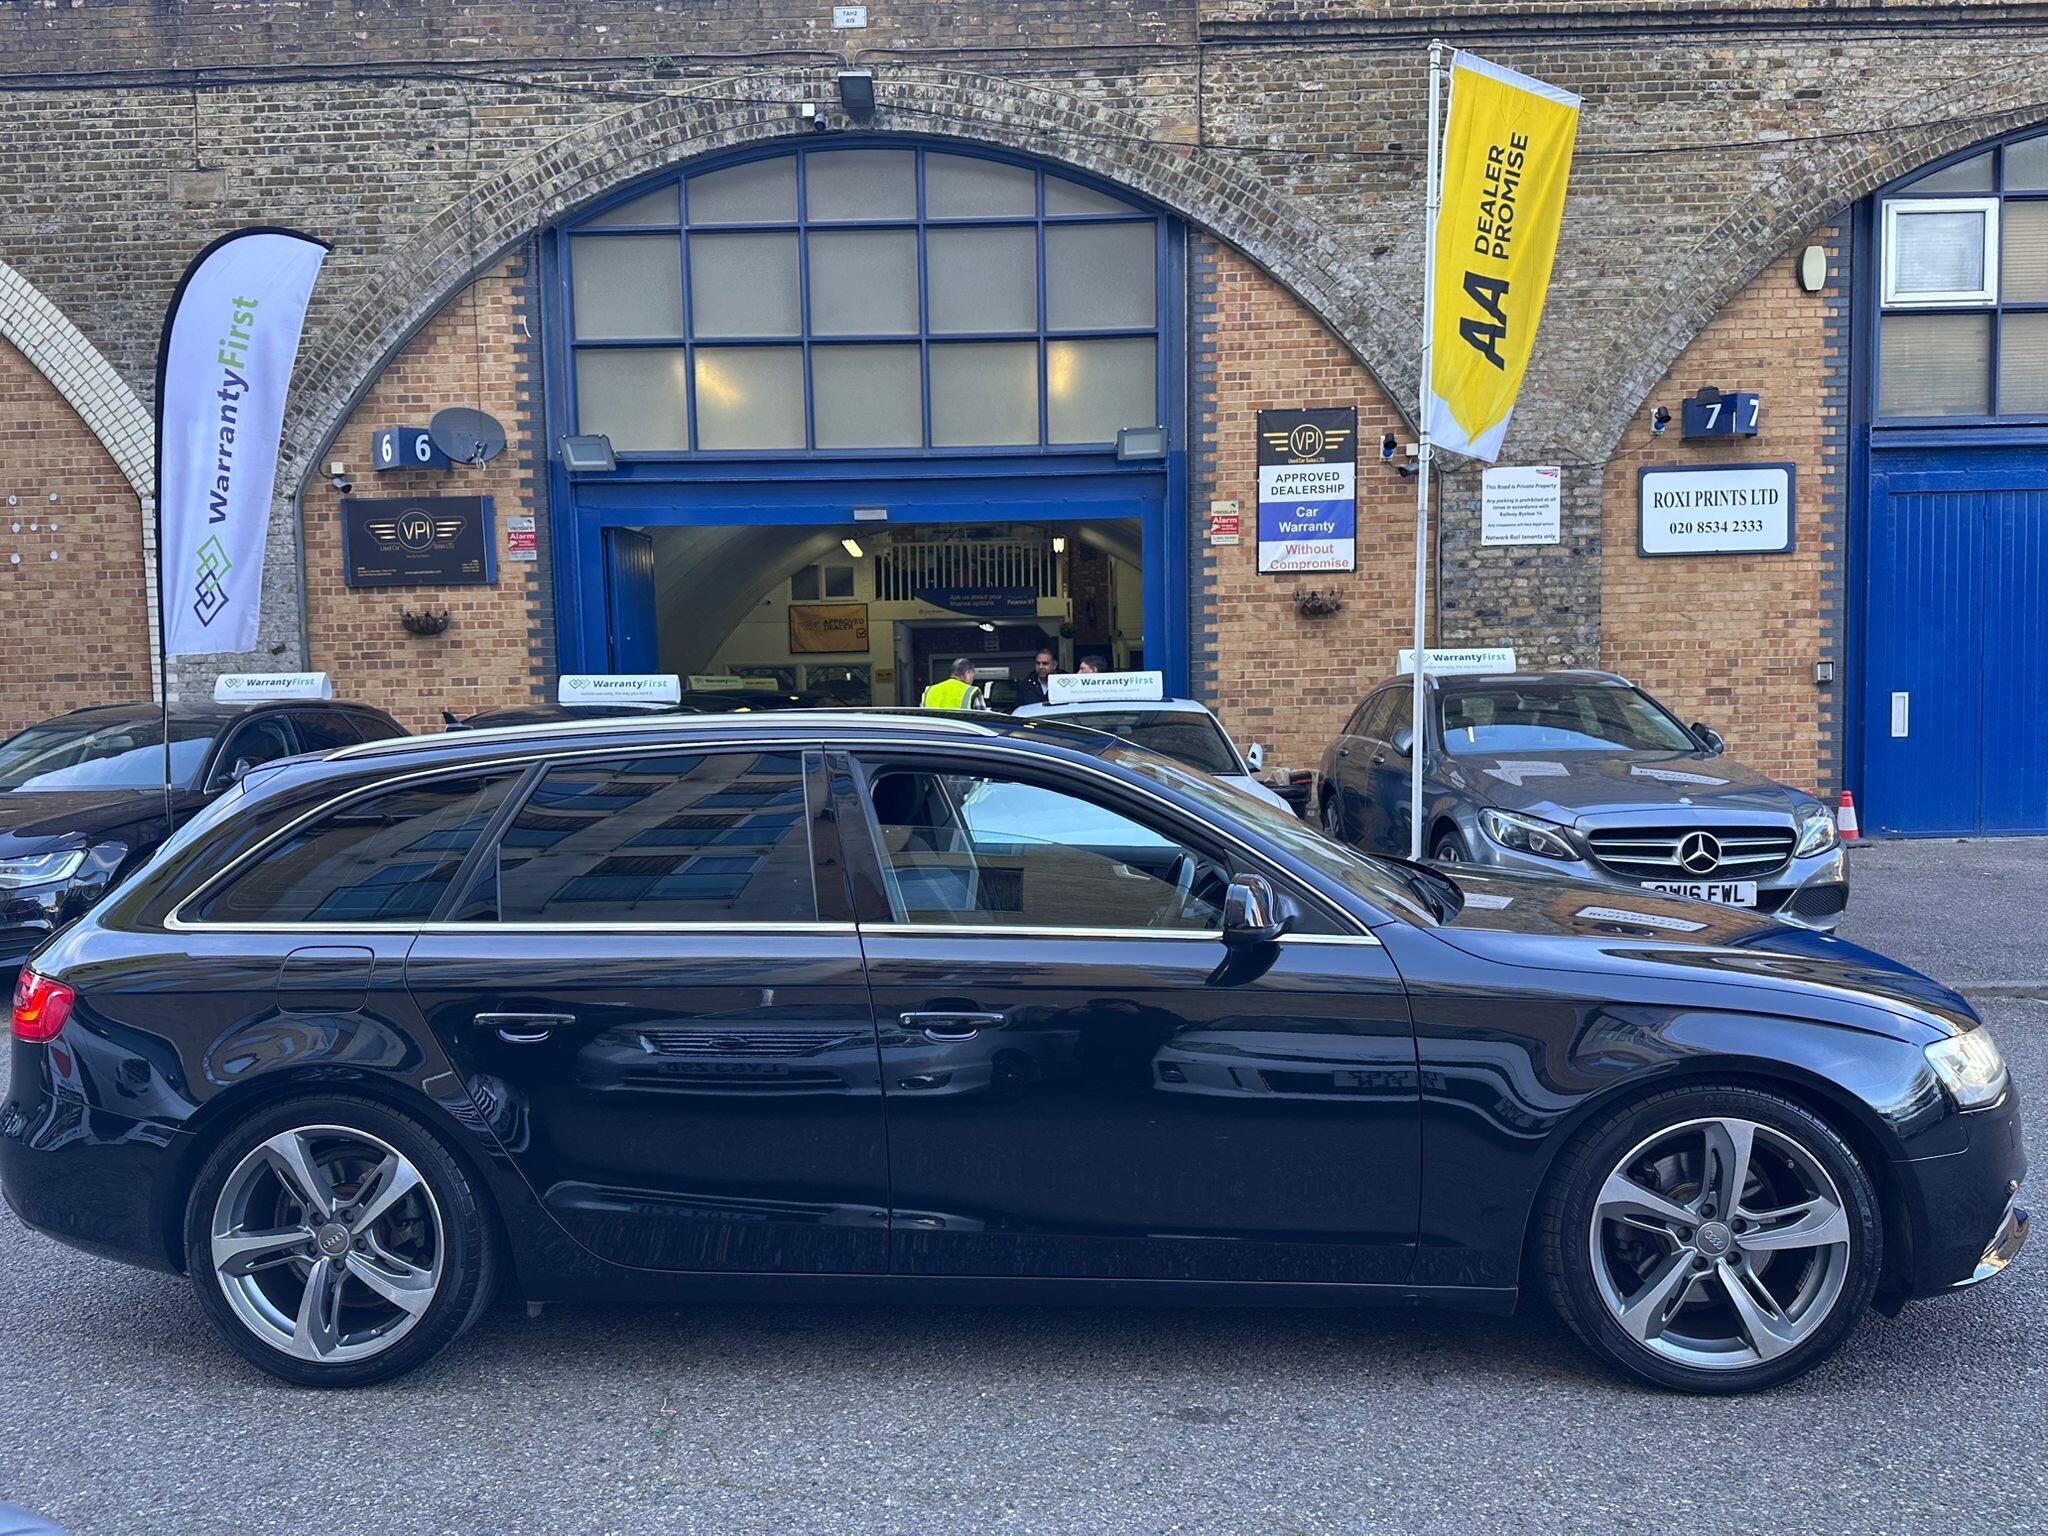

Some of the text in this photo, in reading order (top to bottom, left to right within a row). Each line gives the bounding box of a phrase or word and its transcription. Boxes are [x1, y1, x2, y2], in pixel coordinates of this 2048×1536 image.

[1474, 144, 1505, 256] DEALER
[1491, 132, 1529, 260] PROMISE
[1459, 270, 1510, 371] AA
[208, 296, 258, 524] WarrantyFirst
[1705, 403, 1722, 429] 7
[1749, 399, 1760, 427] 7
[1294, 431, 1320, 451] VPI
[381, 433, 392, 463] 6
[415, 434, 431, 462] 6
[1275, 472, 1340, 483] APPROVED
[1271, 484, 1345, 496] DEALERSHIP
[1654, 488, 1779, 508] ROXI PRINTS LTD
[1296, 506, 1318, 518] Car
[1213, 516, 1238, 524] Alarm
[1669, 519, 1763, 534] 020 8534 2333
[402, 520, 431, 540] VPI
[1279, 521, 1335, 534] Warranty
[510, 532, 535, 540] Alarm
[1285, 543, 1334, 555] Without
[1270, 558, 1349, 571] Compromise
[823, 617, 865, 625] APPROVED
[823, 623, 854, 631] DEALER
[1433, 653, 1507, 663] WarrantyFirst
[246, 677, 315, 687] WarrantyFirst
[593, 679, 668, 689] WarrantyFirst
[1080, 676, 1154, 687] WarrantyFirst
